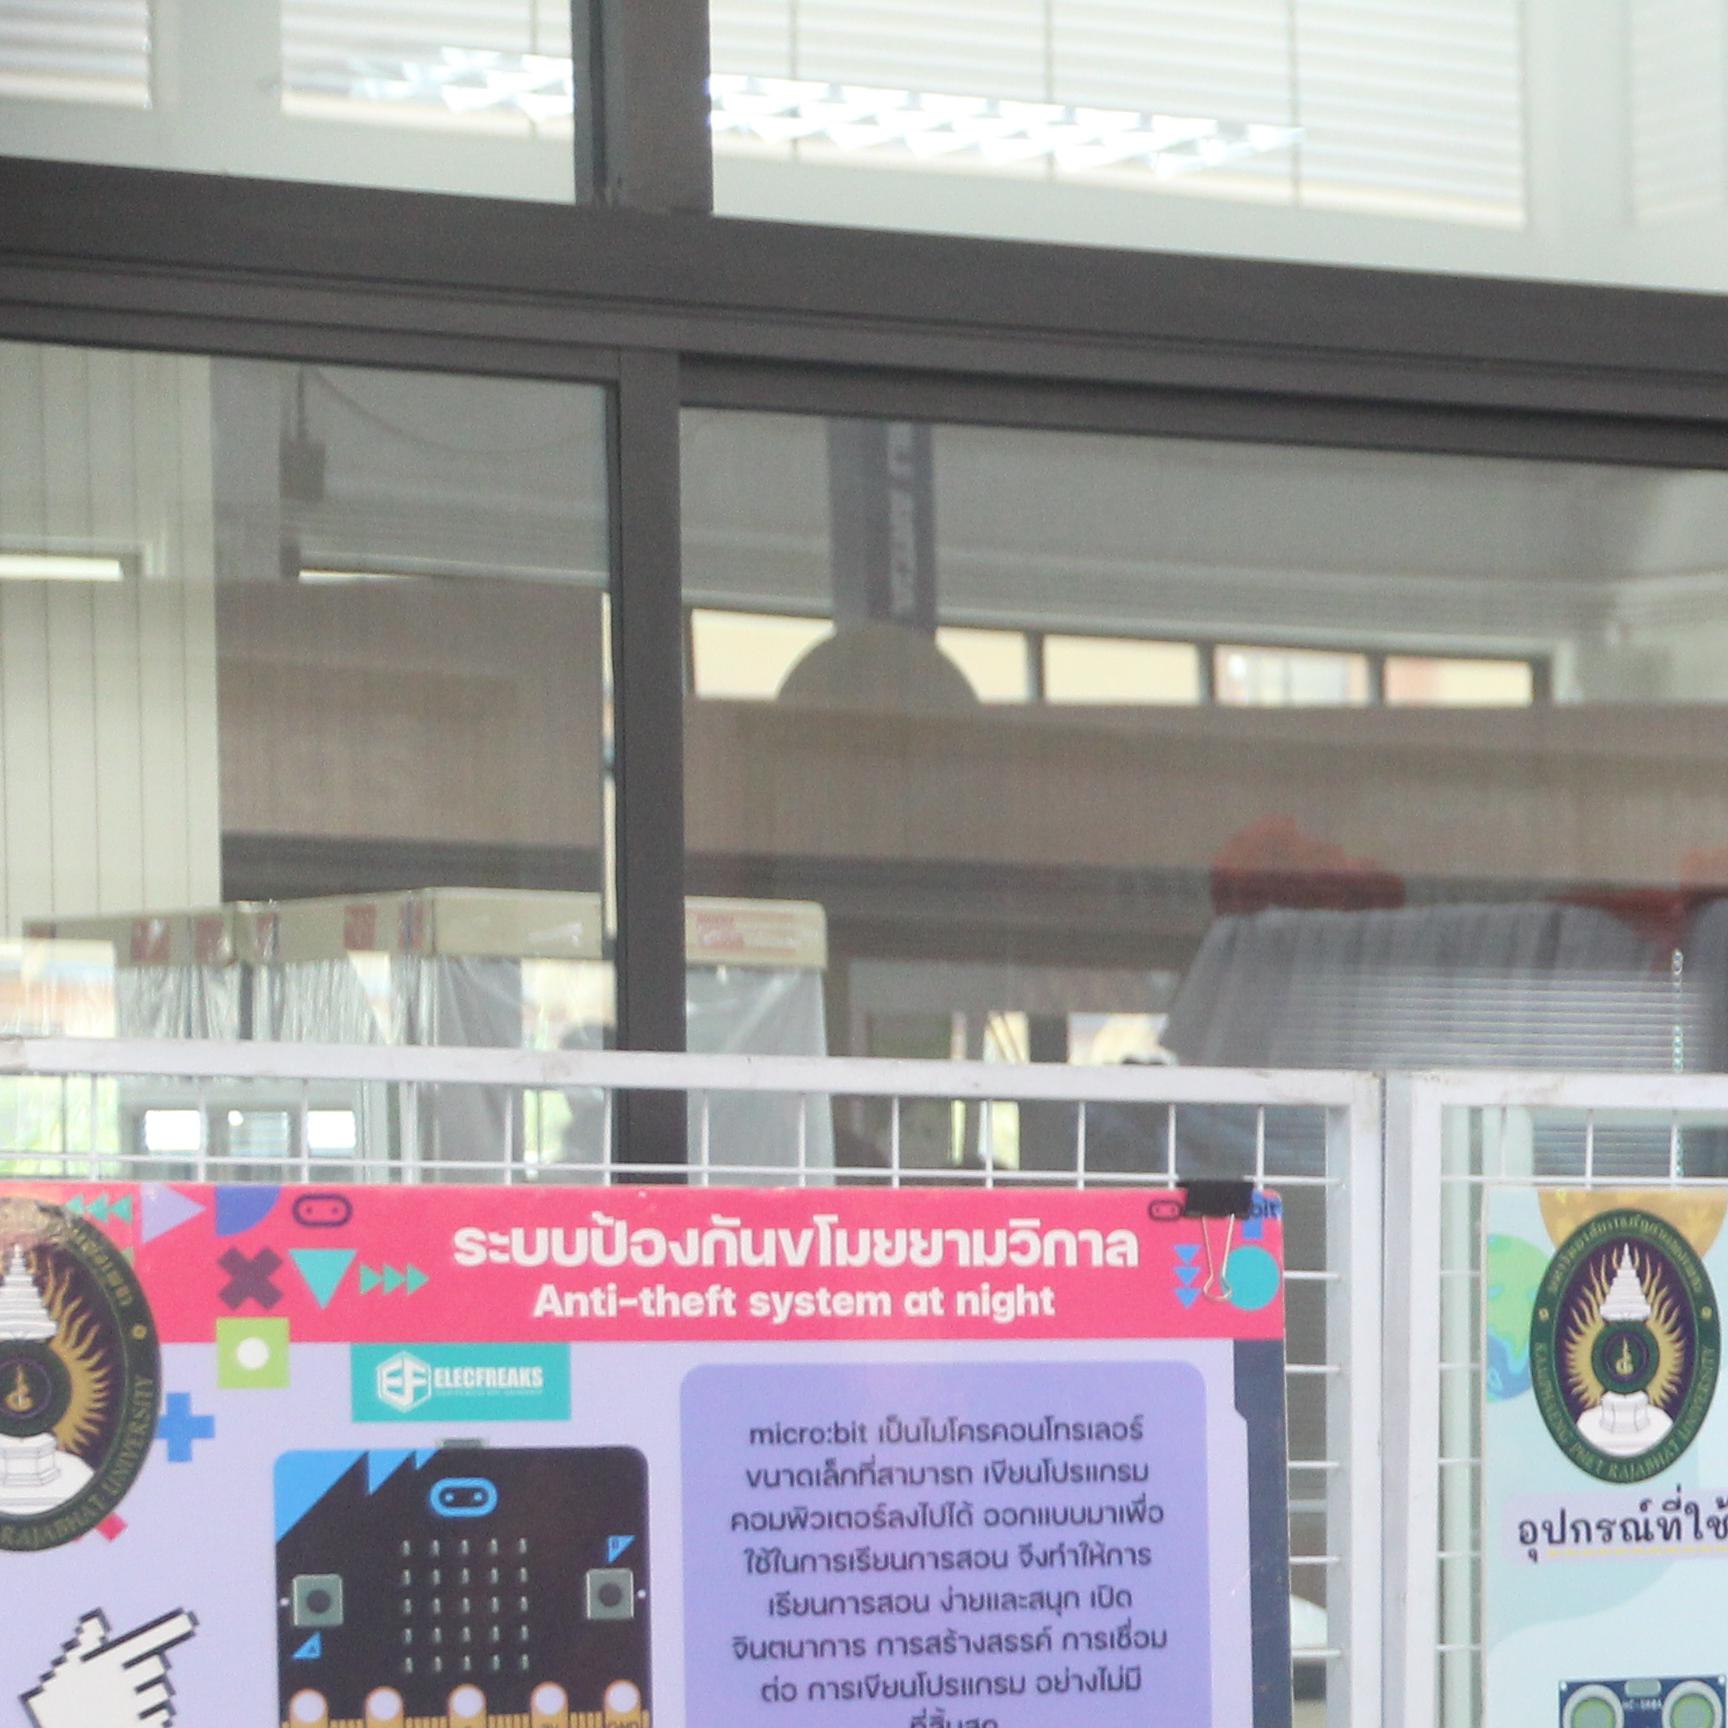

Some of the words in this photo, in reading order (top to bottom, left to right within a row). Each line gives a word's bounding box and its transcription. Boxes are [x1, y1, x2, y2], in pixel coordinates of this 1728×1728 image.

[453, 1209, 1139, 1267] ระบบป้องกันขโมยยามวิกาล
[533, 1282, 737, 1319] Anti-theft
[749, 1285, 892, 1326] system
[903, 1286, 945, 1317] at
[955, 1281, 1056, 1325] night
[433, 1365, 545, 1389] ELECFREAKS
[749, 1420, 867, 1445] micro:bit
[746, 1453, 974, 1488] ขนาดเล็กที่สามารถ
[983, 1457, 1150, 1485] เขียนโปรแกรม
[983, 1492, 1165, 1527] ออกแบบมาเพื่อ
[743, 1545, 1009, 1575] ใช้ในการเรียนการสอน
[1018, 1541, 1152, 1569] จึงทำให้การ
[768, 1589, 930, 1617] เรียนการสอน
[940, 1584, 1081, 1618] ง่ายและสนุก
[1090, 1584, 1133, 1609] เปิด
[731, 1635, 867, 1661] จินตนาการ
[877, 1627, 1053, 1656] การสร้างสรรค์
[1062, 1616, 1168, 1650] การเชื่อม
[760, 1674, 799, 1703] ต่อ
[807, 1670, 1027, 1701] การเขียนโปรแกรม
[1036, 1665, 1142, 1694] อย่างไม่มี
